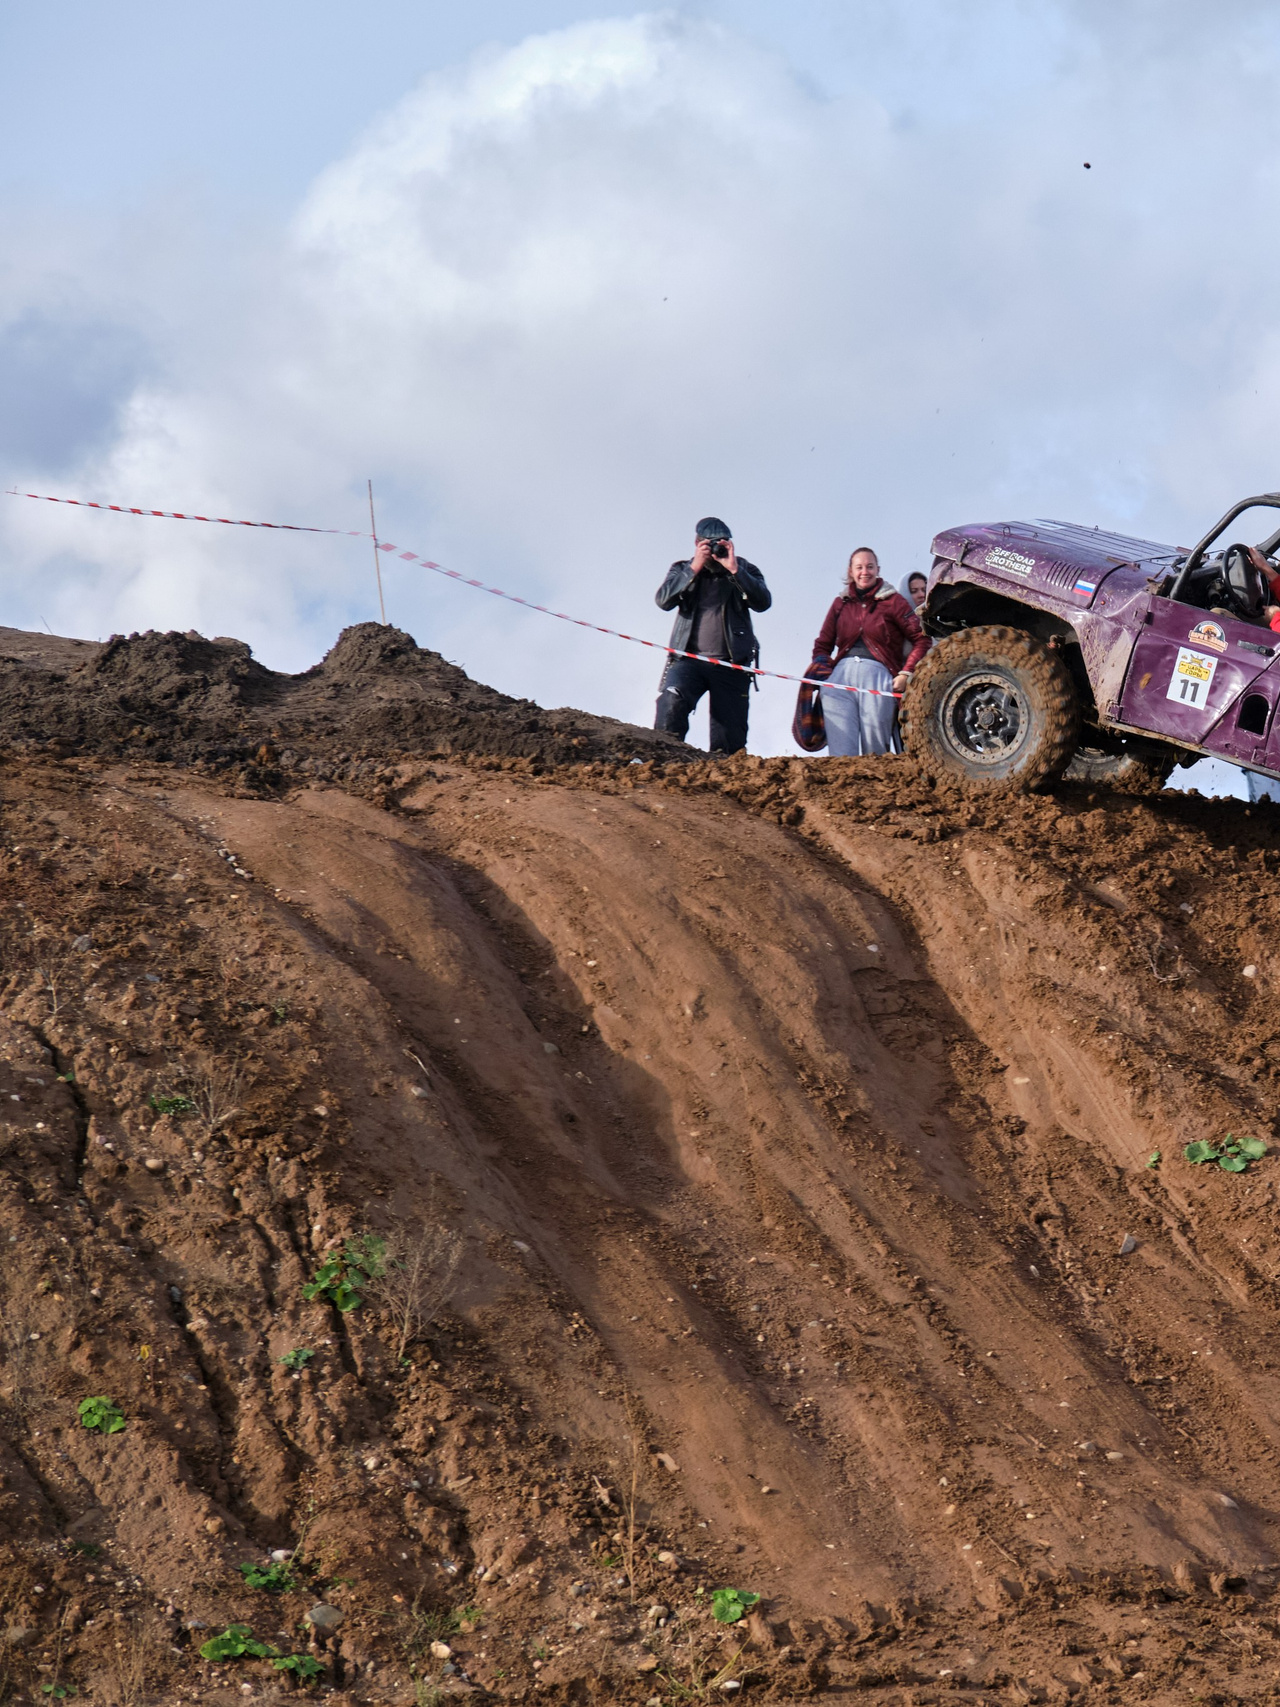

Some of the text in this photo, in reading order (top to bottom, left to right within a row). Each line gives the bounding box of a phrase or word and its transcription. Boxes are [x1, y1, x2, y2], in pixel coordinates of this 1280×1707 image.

[985, 553, 1033, 574] BROTHERS
[1009, 552, 1036, 566] ROAD
[1180, 678, 1200, 703] 11
